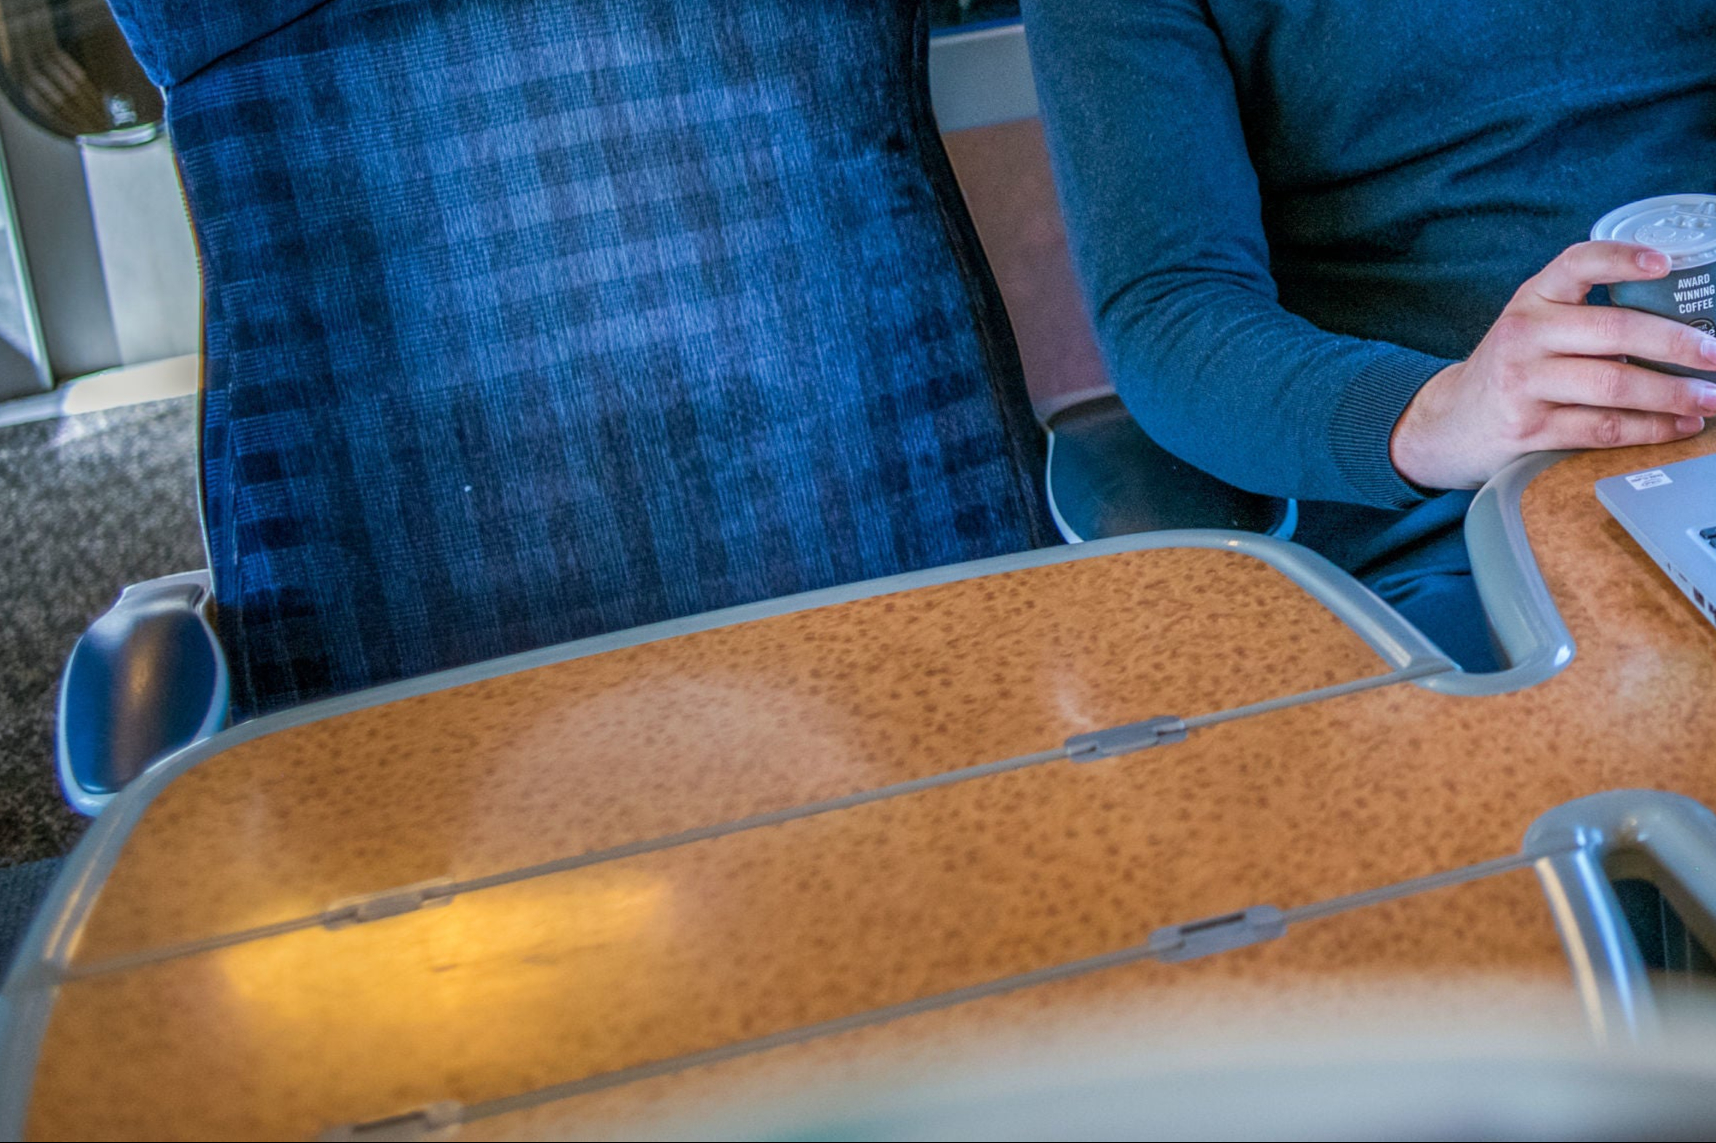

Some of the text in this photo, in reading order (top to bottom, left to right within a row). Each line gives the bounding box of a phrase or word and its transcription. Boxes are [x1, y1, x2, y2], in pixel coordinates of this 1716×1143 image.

[1677, 273, 1711, 289] AWARD
[1673, 284, 1716, 302] WINNING
[1678, 298, 1714, 315] COFFEE
